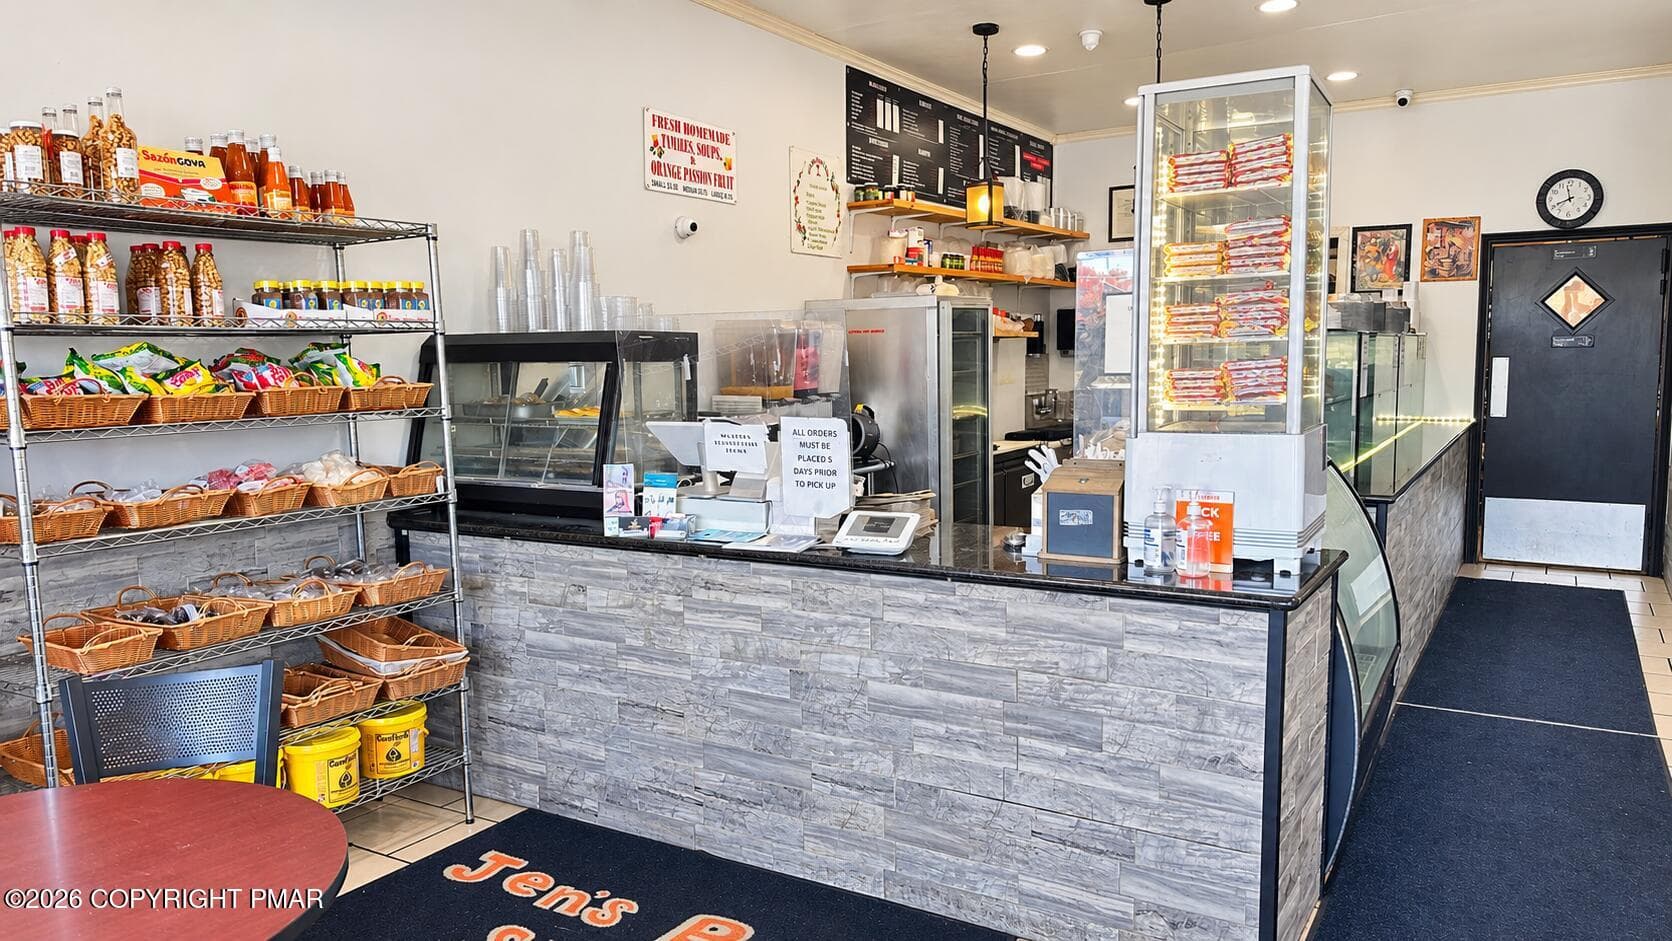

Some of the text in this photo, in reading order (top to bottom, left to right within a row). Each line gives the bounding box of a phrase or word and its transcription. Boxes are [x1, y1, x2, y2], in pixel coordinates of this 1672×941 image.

[652, 114, 731, 146] FRESH HOMEMADE
[651, 160, 735, 190] ORANGE PASSION FRUIT
[792, 428, 838, 438] ALL ORDERS
[799, 441, 831, 450] MUST BE
[797, 454, 826, 463] PLACED
[793, 467, 838, 477] DAYS PRIOR
[795, 480, 836, 490] TO PICK UP
[443, 850, 639, 927] Jen's
